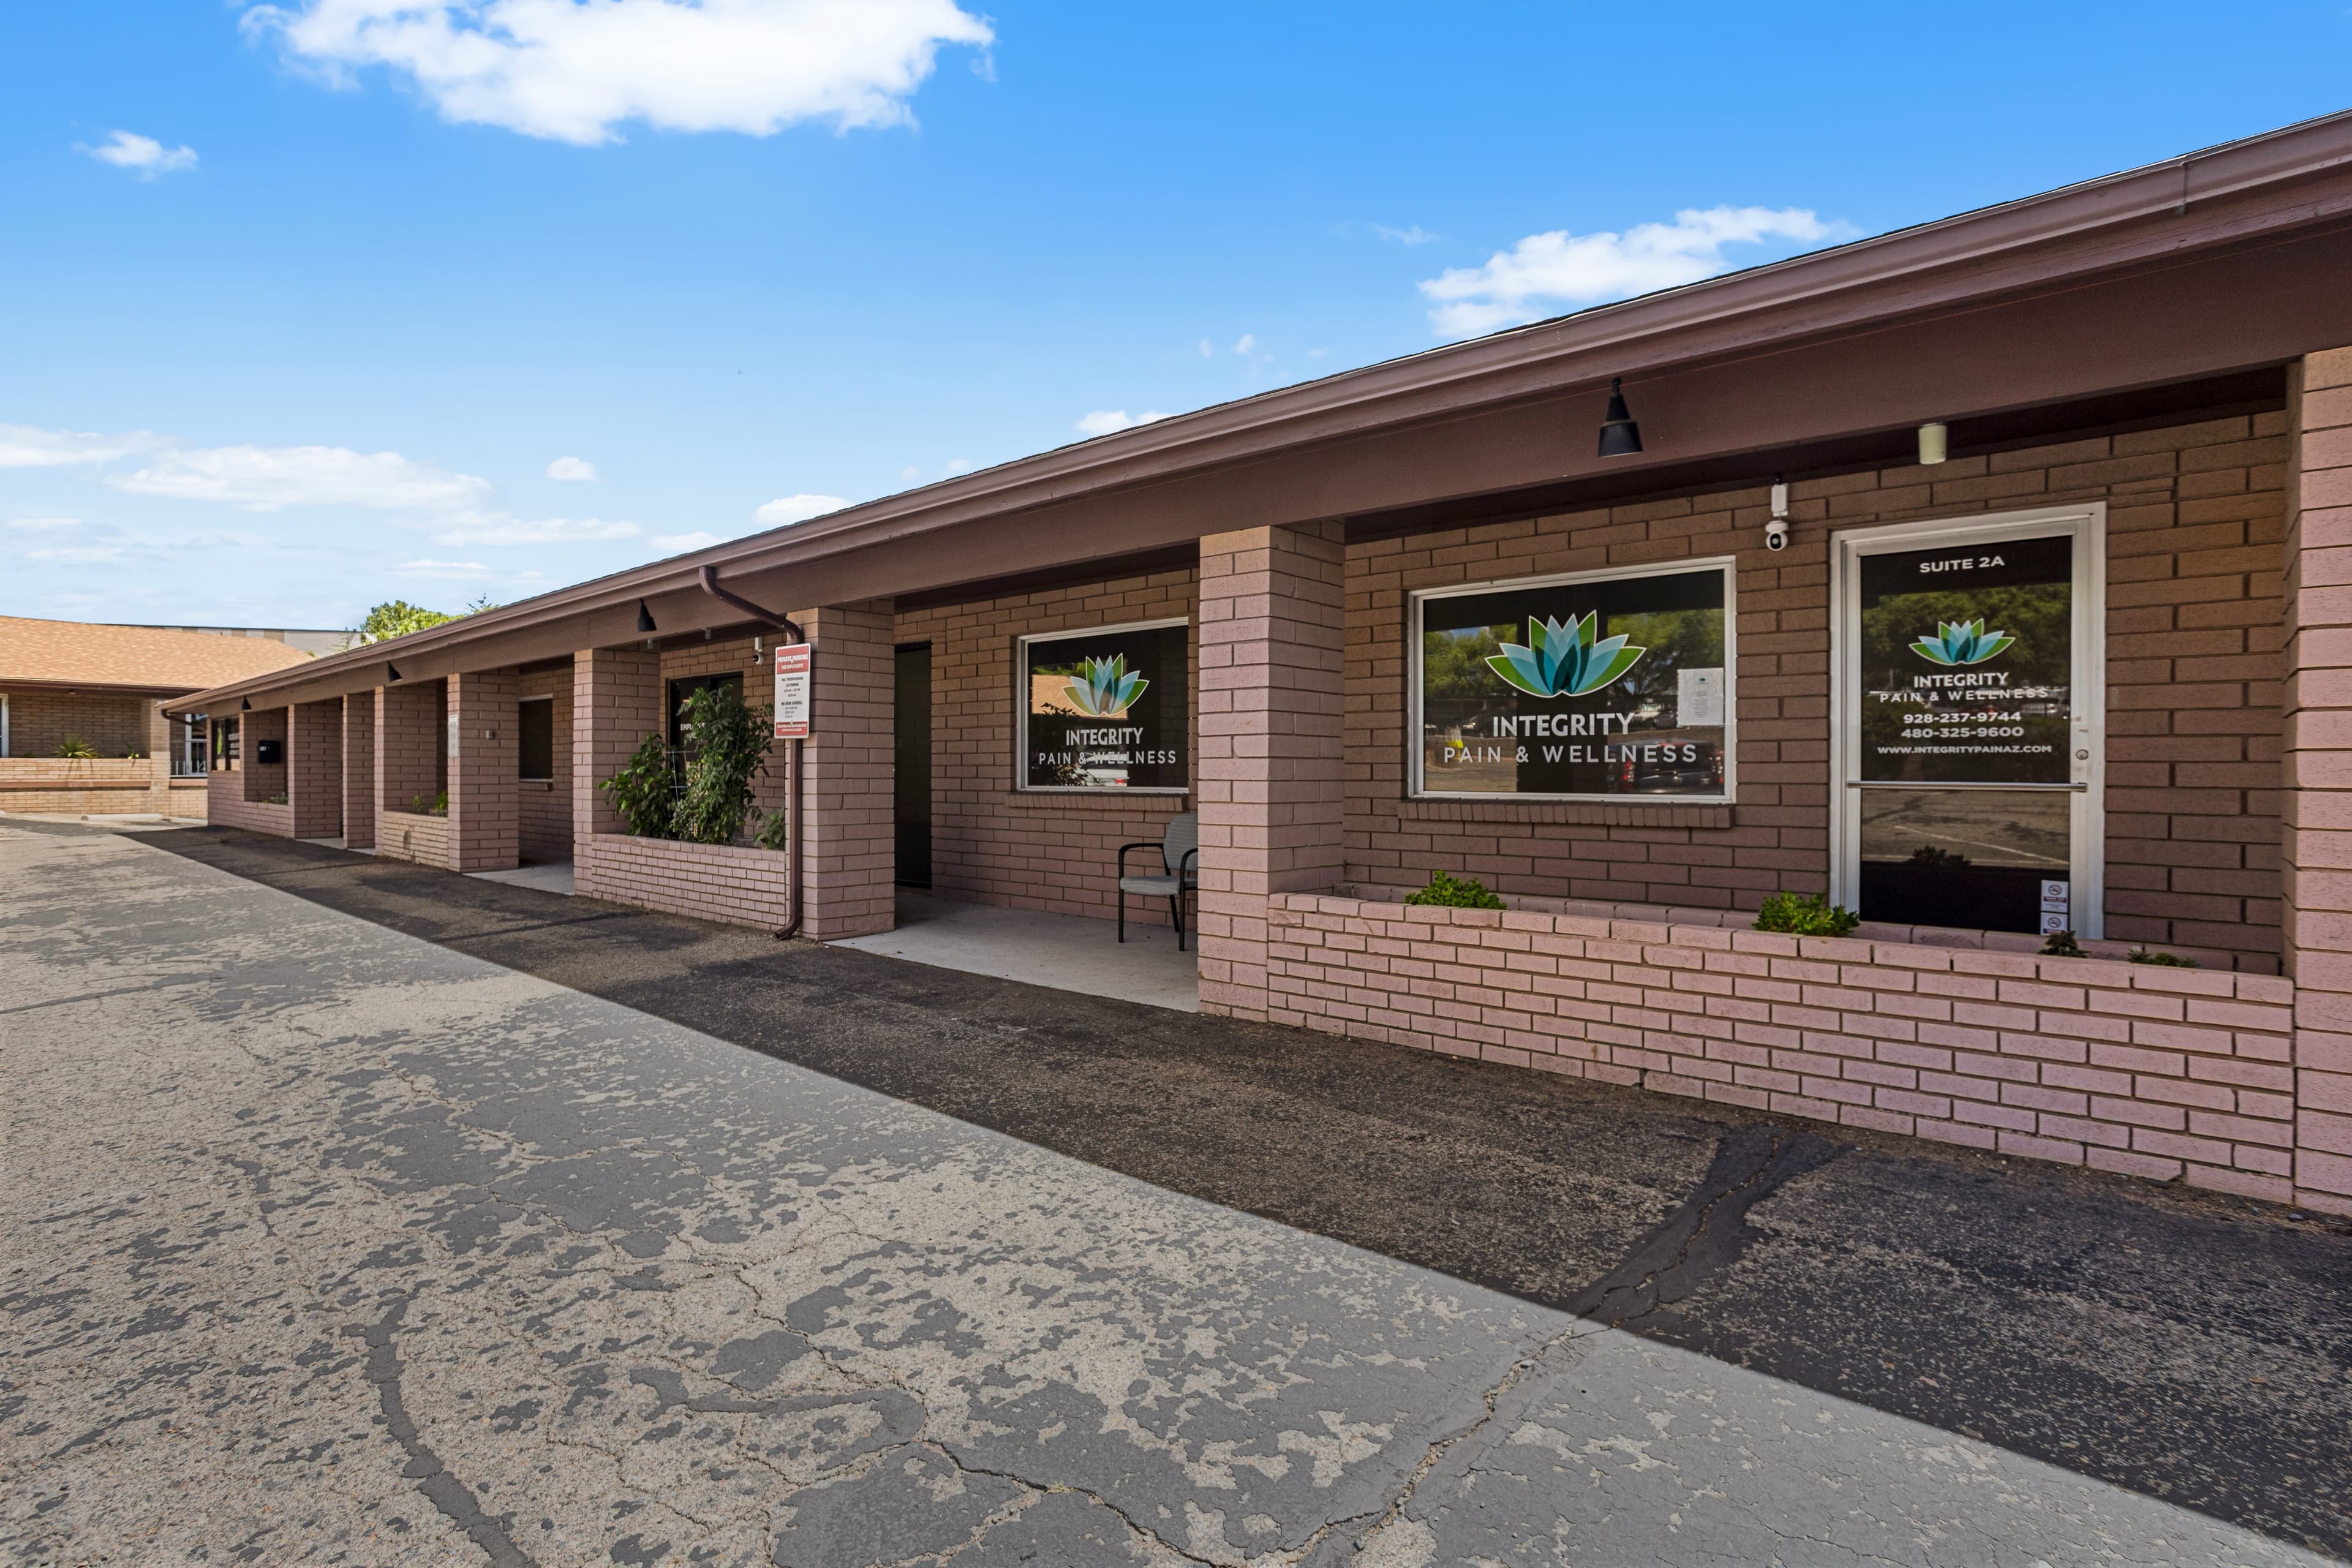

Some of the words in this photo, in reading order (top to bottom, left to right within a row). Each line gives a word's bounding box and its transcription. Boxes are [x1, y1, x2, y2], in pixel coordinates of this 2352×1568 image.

[1919, 559, 1973, 573] SUITE
[1978, 556, 2005, 568] 2A
[1913, 672, 2009, 688] INTEGRITY
[1879, 692, 1921, 703] PAIN
[1929, 692, 1940, 701] &
[1948, 688, 2049, 701] WELLNESS
[1493, 712, 1635, 737] INTEGRITY
[1903, 712, 2021, 724] 928-237-9744
[1066, 727, 1144, 745] INTEGRITY
[1901, 726, 2024, 739] 480-325-9600
[1039, 752, 1071, 765] PAIN
[1078, 753, 1087, 765] &
[1093, 750, 1176, 764] WELLNESS
[1444, 746, 1501, 763] PAIN
[1515, 745, 1529, 763] &
[1542, 744, 1697, 763] WELLNESS
[1877, 745, 2052, 755] WWW.INTEGRITYPAINAZ.COM
